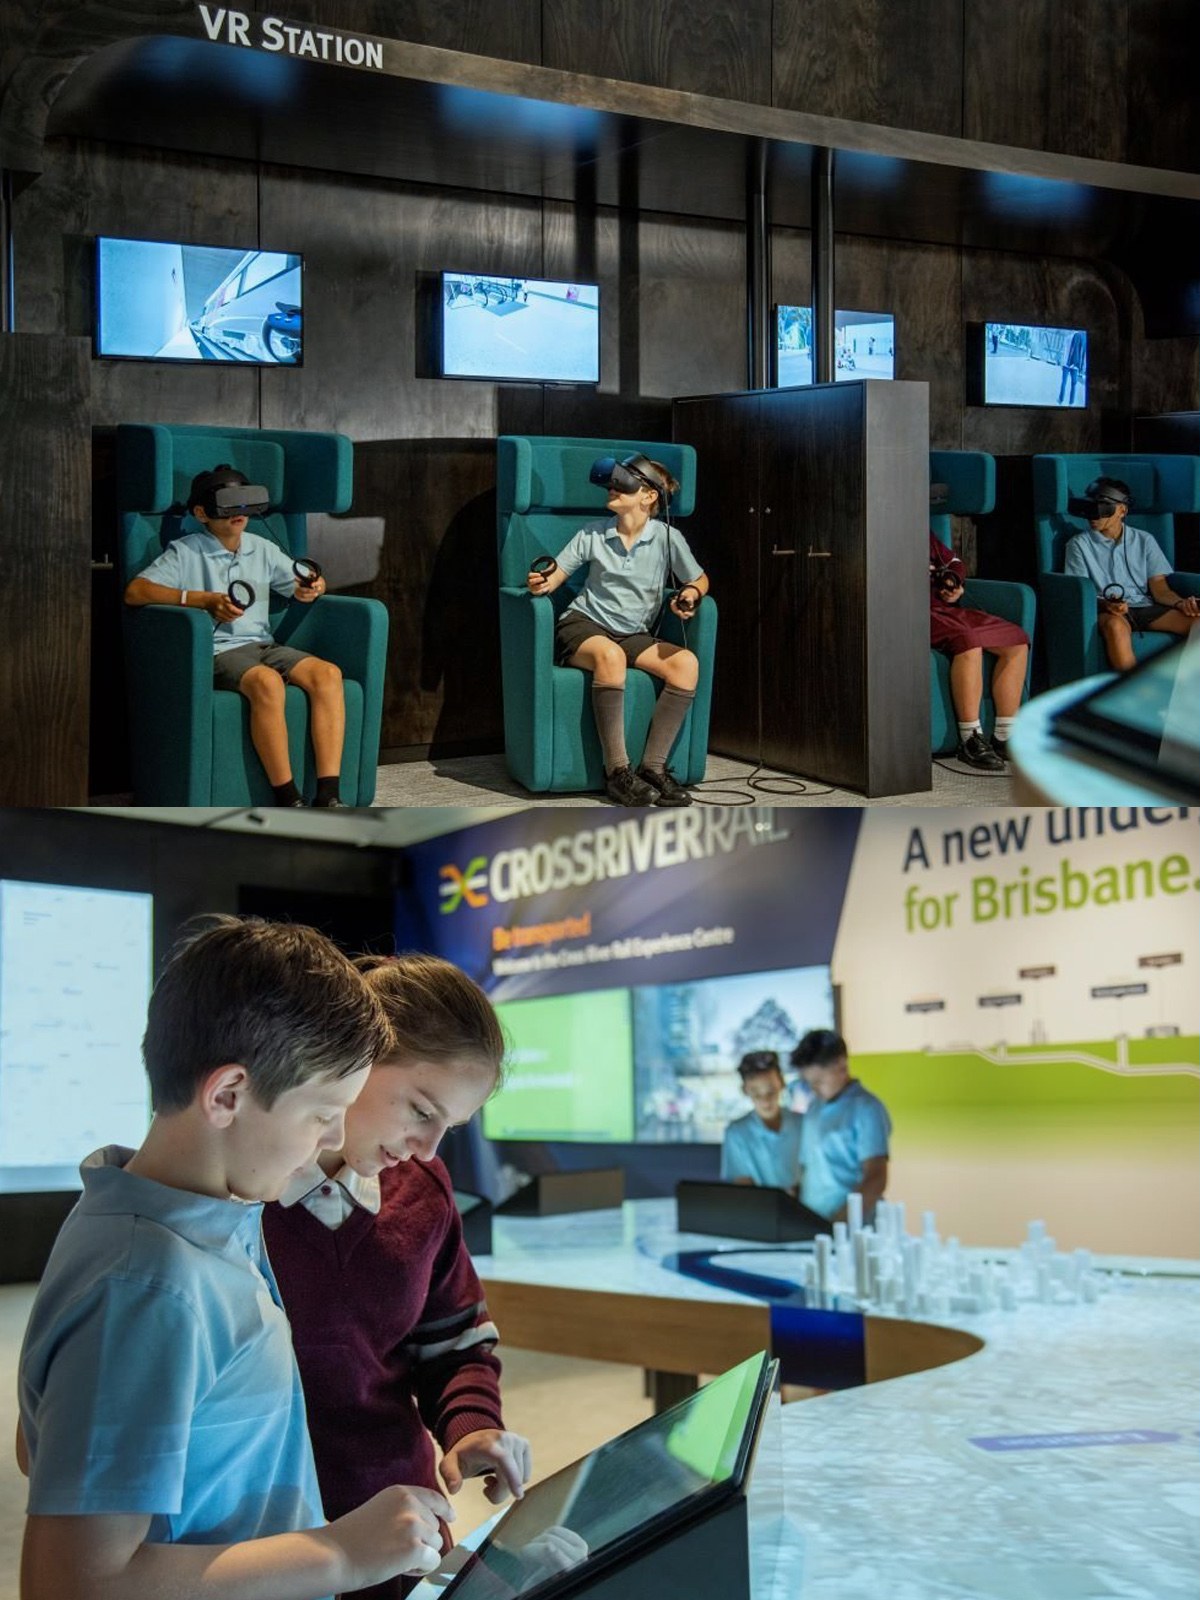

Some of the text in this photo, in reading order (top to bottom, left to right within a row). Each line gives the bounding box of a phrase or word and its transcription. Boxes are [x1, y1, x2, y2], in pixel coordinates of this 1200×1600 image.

[199, 5, 251, 46] VR
[903, 827, 930, 874] A
[942, 814, 1031, 867] new
[903, 884, 958, 934] for
